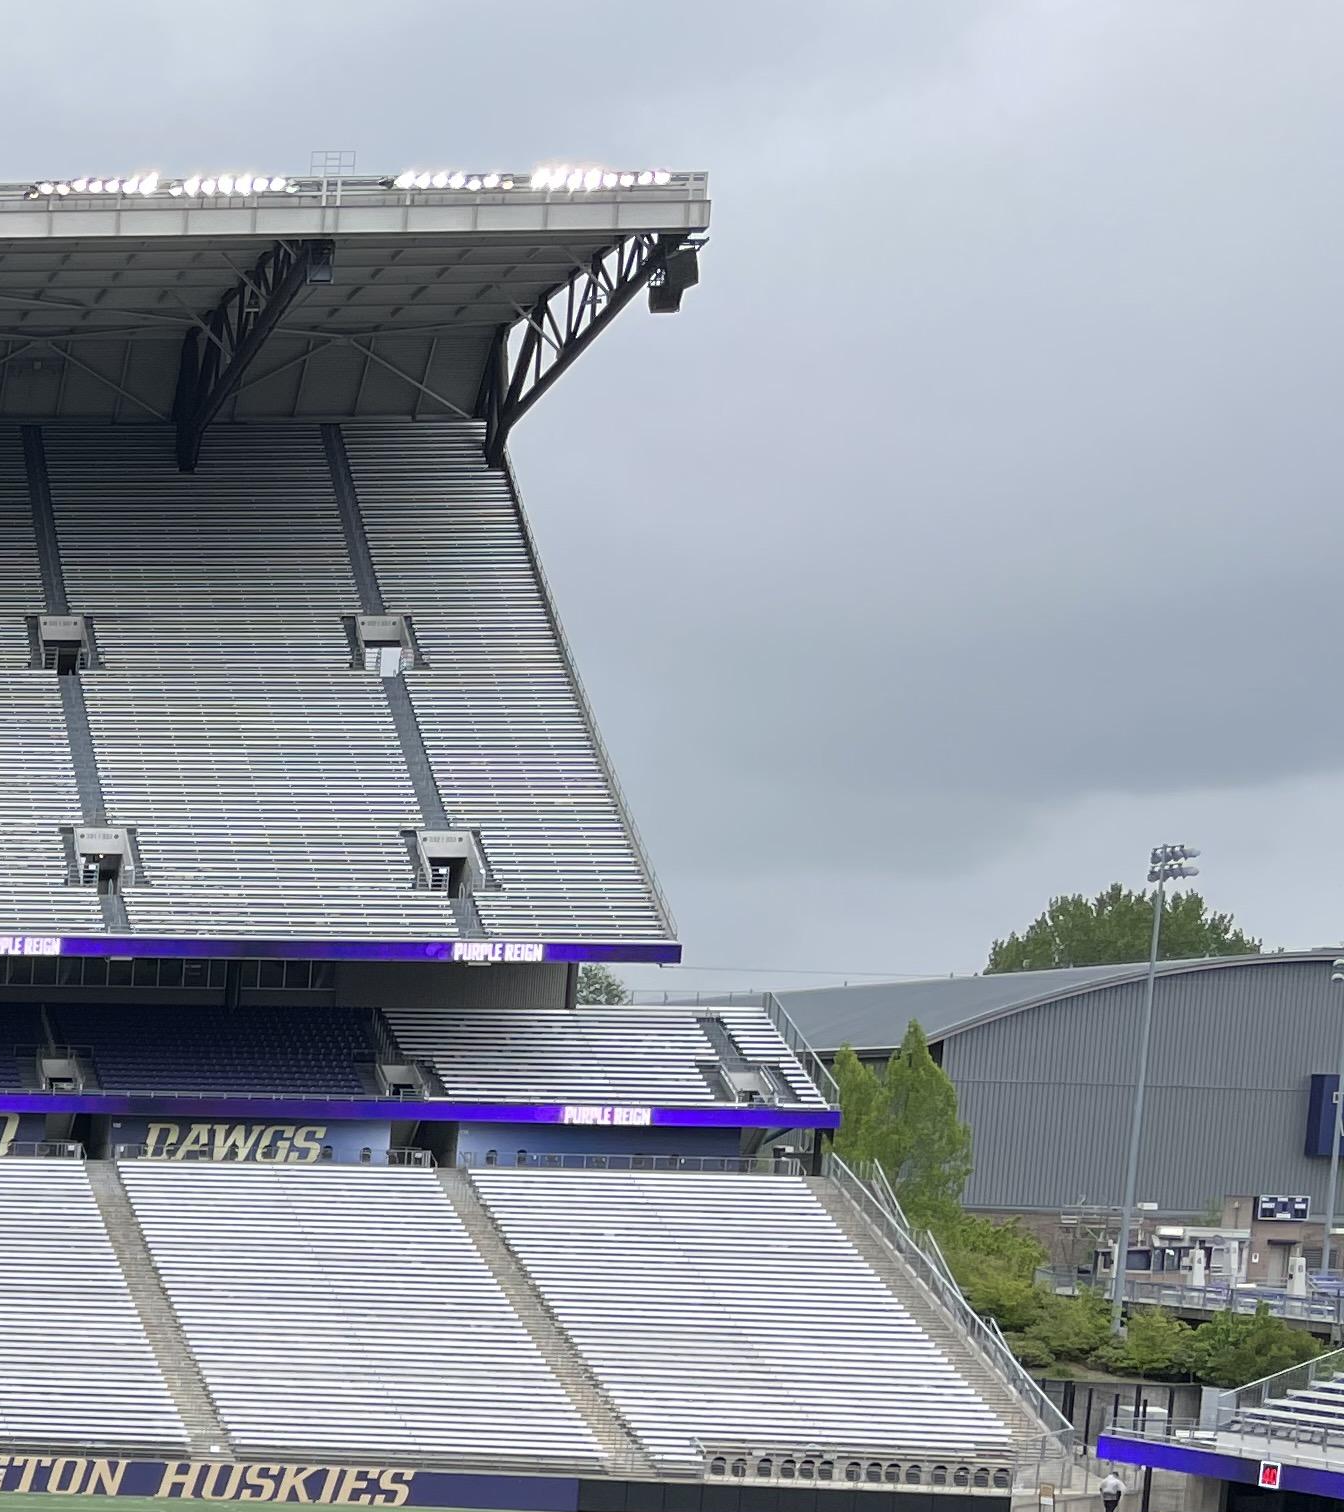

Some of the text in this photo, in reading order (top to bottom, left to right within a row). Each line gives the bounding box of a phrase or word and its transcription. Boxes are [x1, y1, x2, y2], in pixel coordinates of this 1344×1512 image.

[24, 938, 61, 955] REIGN
[454, 943, 543, 961] PURPLE REIGN
[564, 1106, 651, 1125] PURPLE REIGN
[138, 1122, 327, 1162] DAWGS
[154, 1460, 418, 1507] HUSKIES
